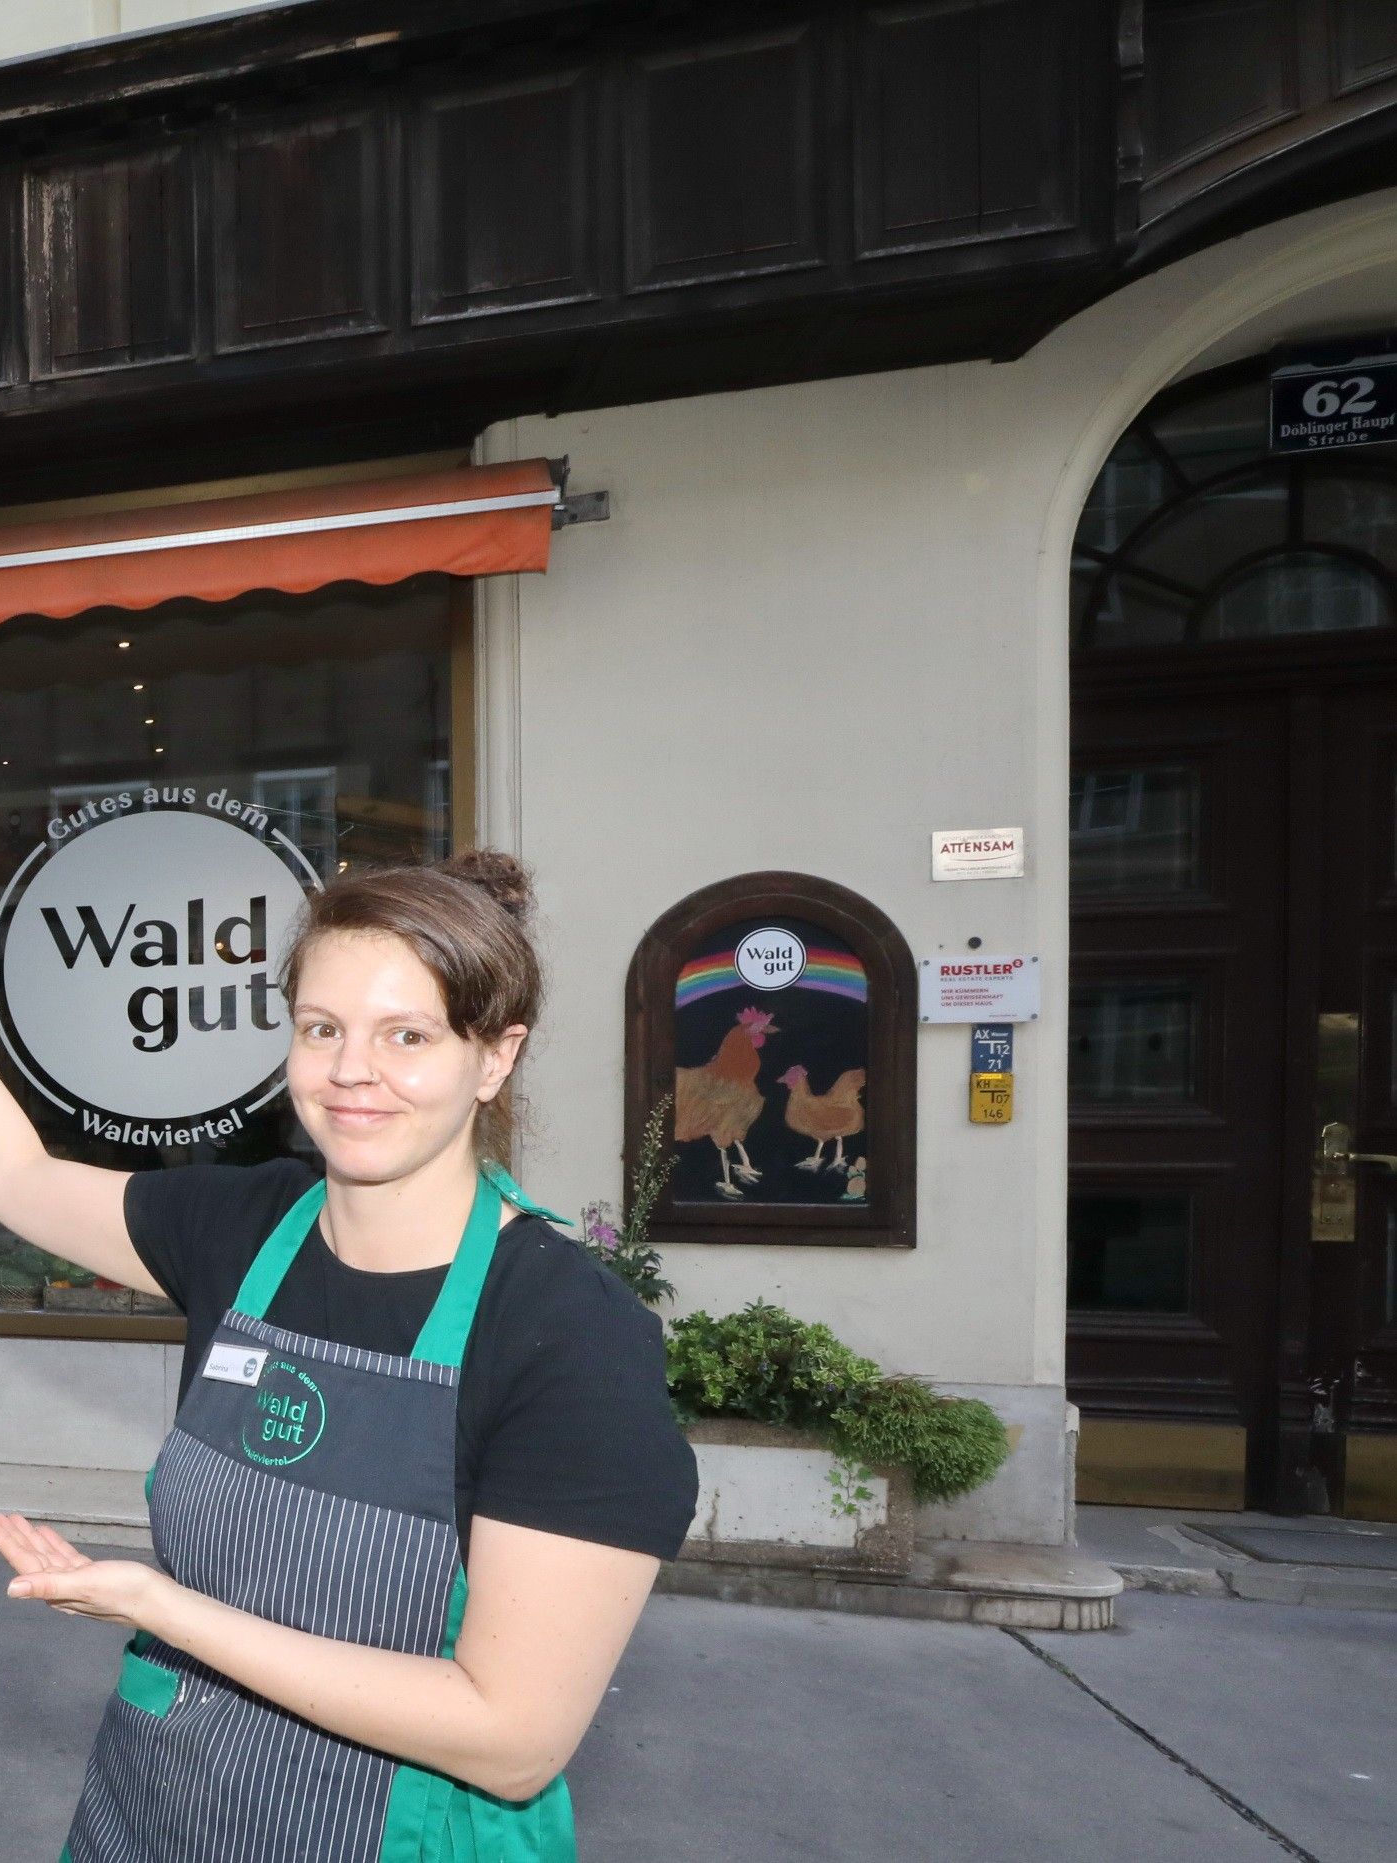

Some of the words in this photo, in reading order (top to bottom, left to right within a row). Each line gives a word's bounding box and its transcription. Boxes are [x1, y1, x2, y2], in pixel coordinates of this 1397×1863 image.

[1302, 376, 1378, 418] 62
[1280, 421, 1349, 438] Döblinger
[47, 789, 134, 841] Gutes
[143, 786, 196, 804] aus
[206, 788, 269, 831] dem
[940, 840, 1014, 854] ATTENSAM
[40, 894, 267, 970] Wald
[746, 946, 793, 961] Wald
[764, 960, 795, 976] gut
[940, 964, 1013, 976] RUSTLER
[127, 972, 282, 1054] gut
[974, 1029, 990, 1040] AX
[82, 1108, 244, 1147] Waldviertel
[262, 1417, 305, 1445] gut
